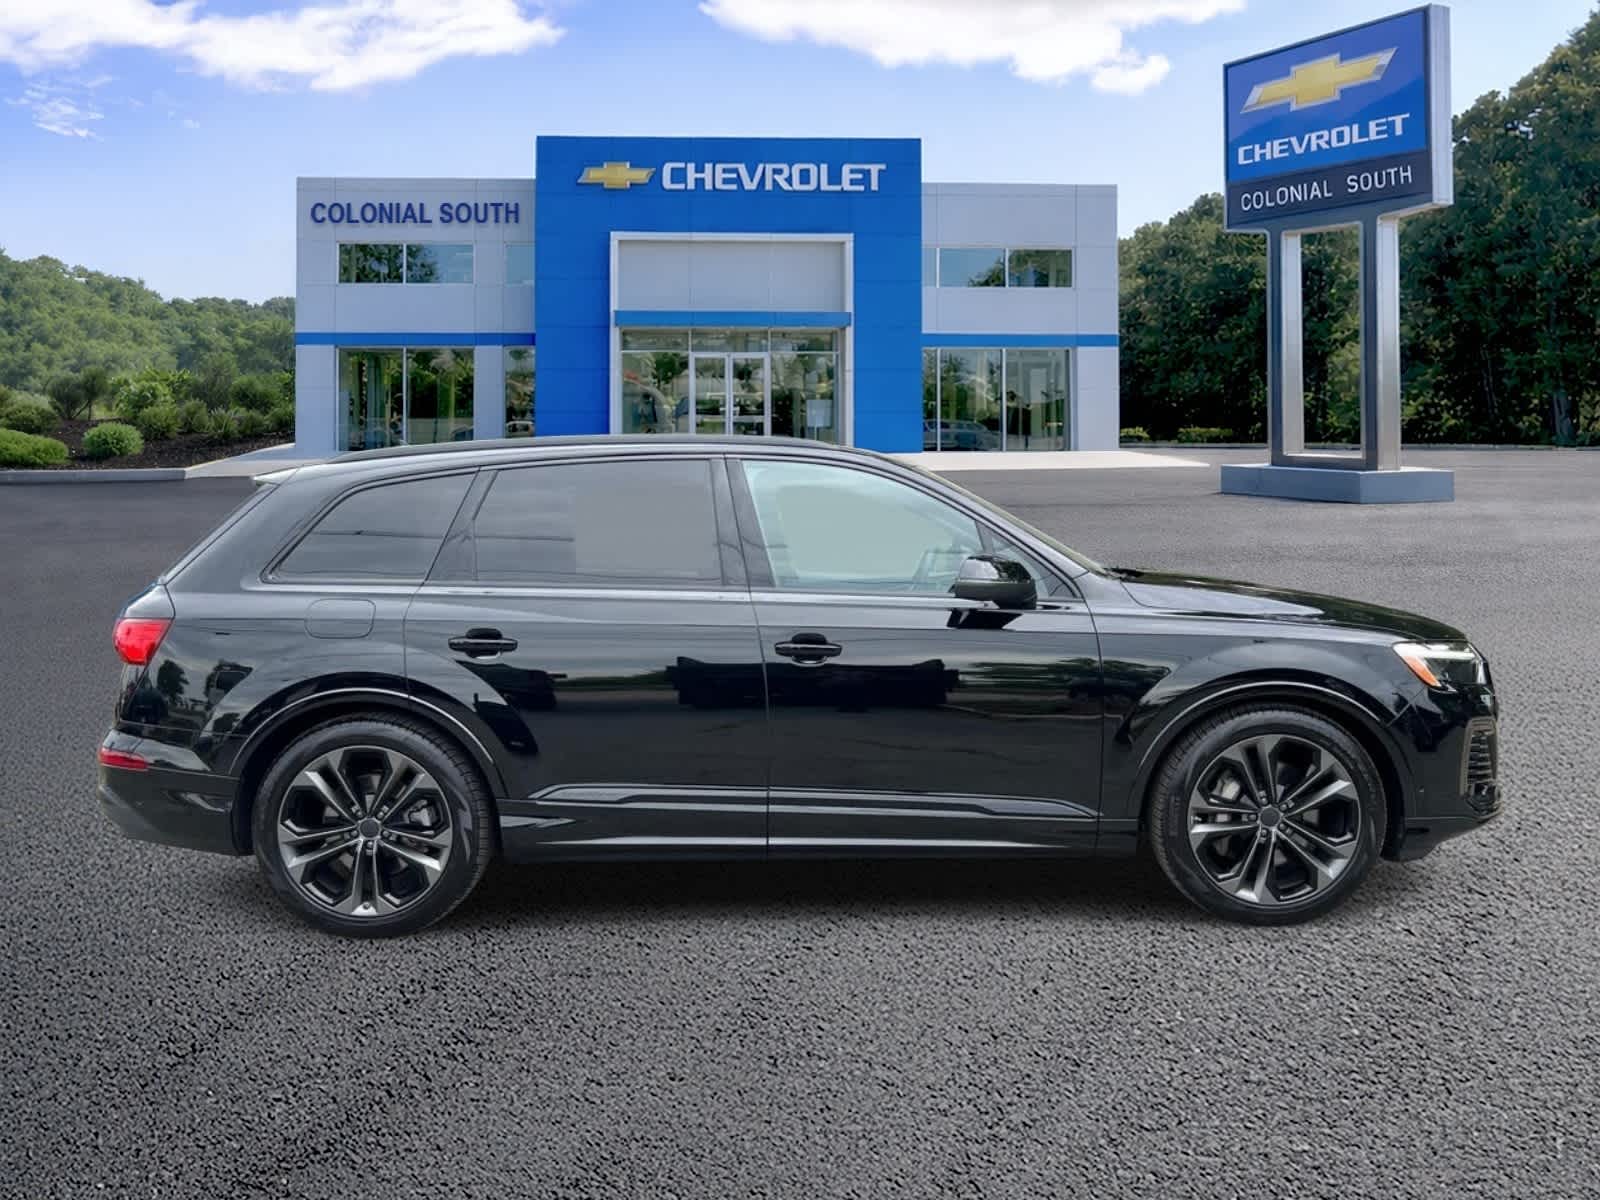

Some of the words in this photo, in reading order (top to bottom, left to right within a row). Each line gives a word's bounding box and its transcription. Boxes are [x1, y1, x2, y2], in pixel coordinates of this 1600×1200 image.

[1237, 113, 1410, 165] CHEVROLET
[662, 162, 887, 192] CHEVROLET
[1240, 179, 1333, 211] COLONIAL
[1346, 165, 1413, 193] SOUTH
[310, 202, 433, 224] COLONIAL
[439, 202, 520, 224] SOUTH
